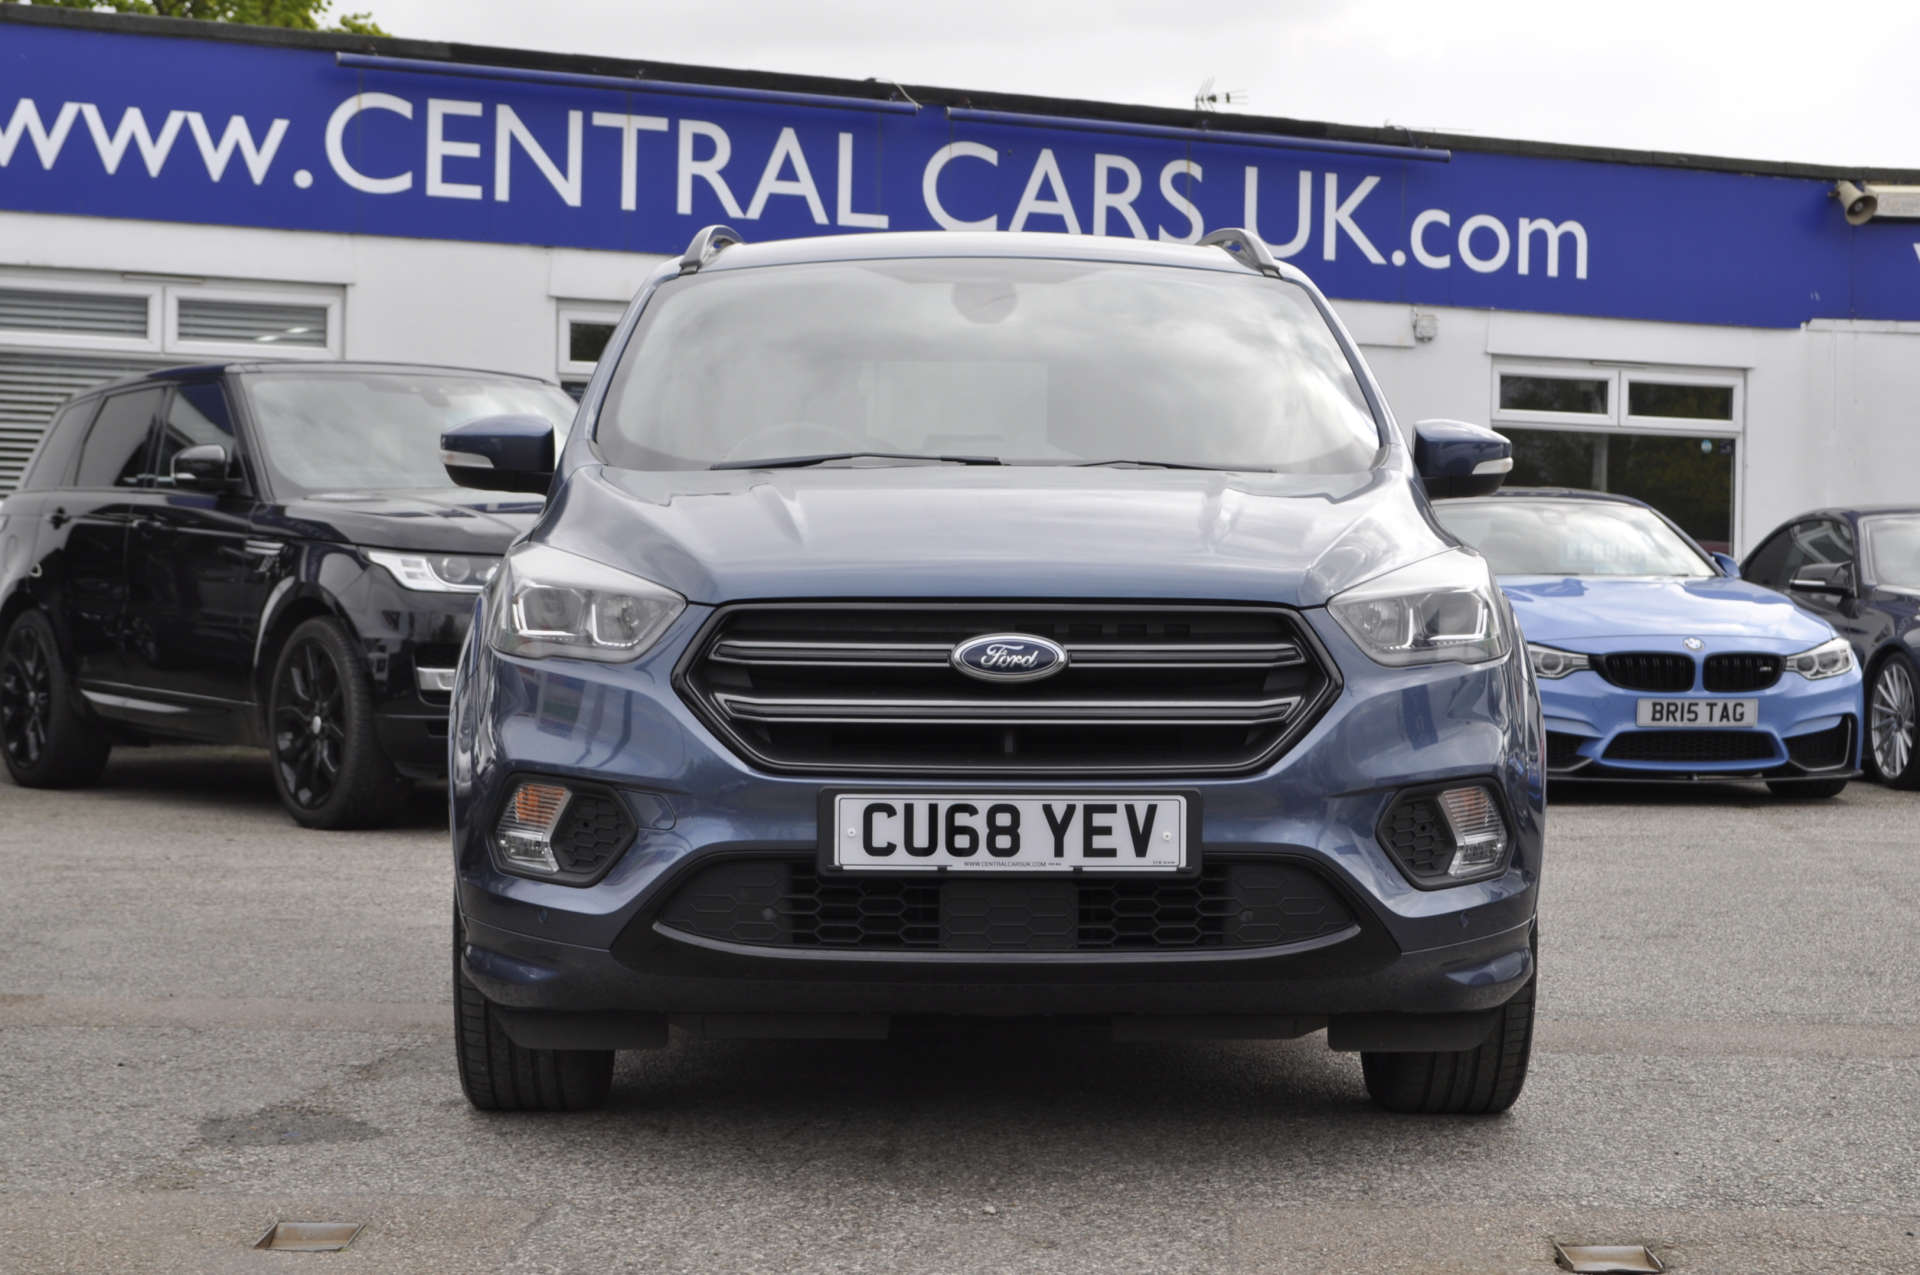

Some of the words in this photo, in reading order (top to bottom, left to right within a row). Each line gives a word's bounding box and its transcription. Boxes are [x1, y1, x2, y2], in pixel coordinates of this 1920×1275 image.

[922, 141, 1205, 245] CARS
[980, 643, 1039, 668] Ford
[1705, 702, 1745, 722] TAG
[862, 802, 1021, 858] CU68
[1041, 803, 1158, 858] YEV
